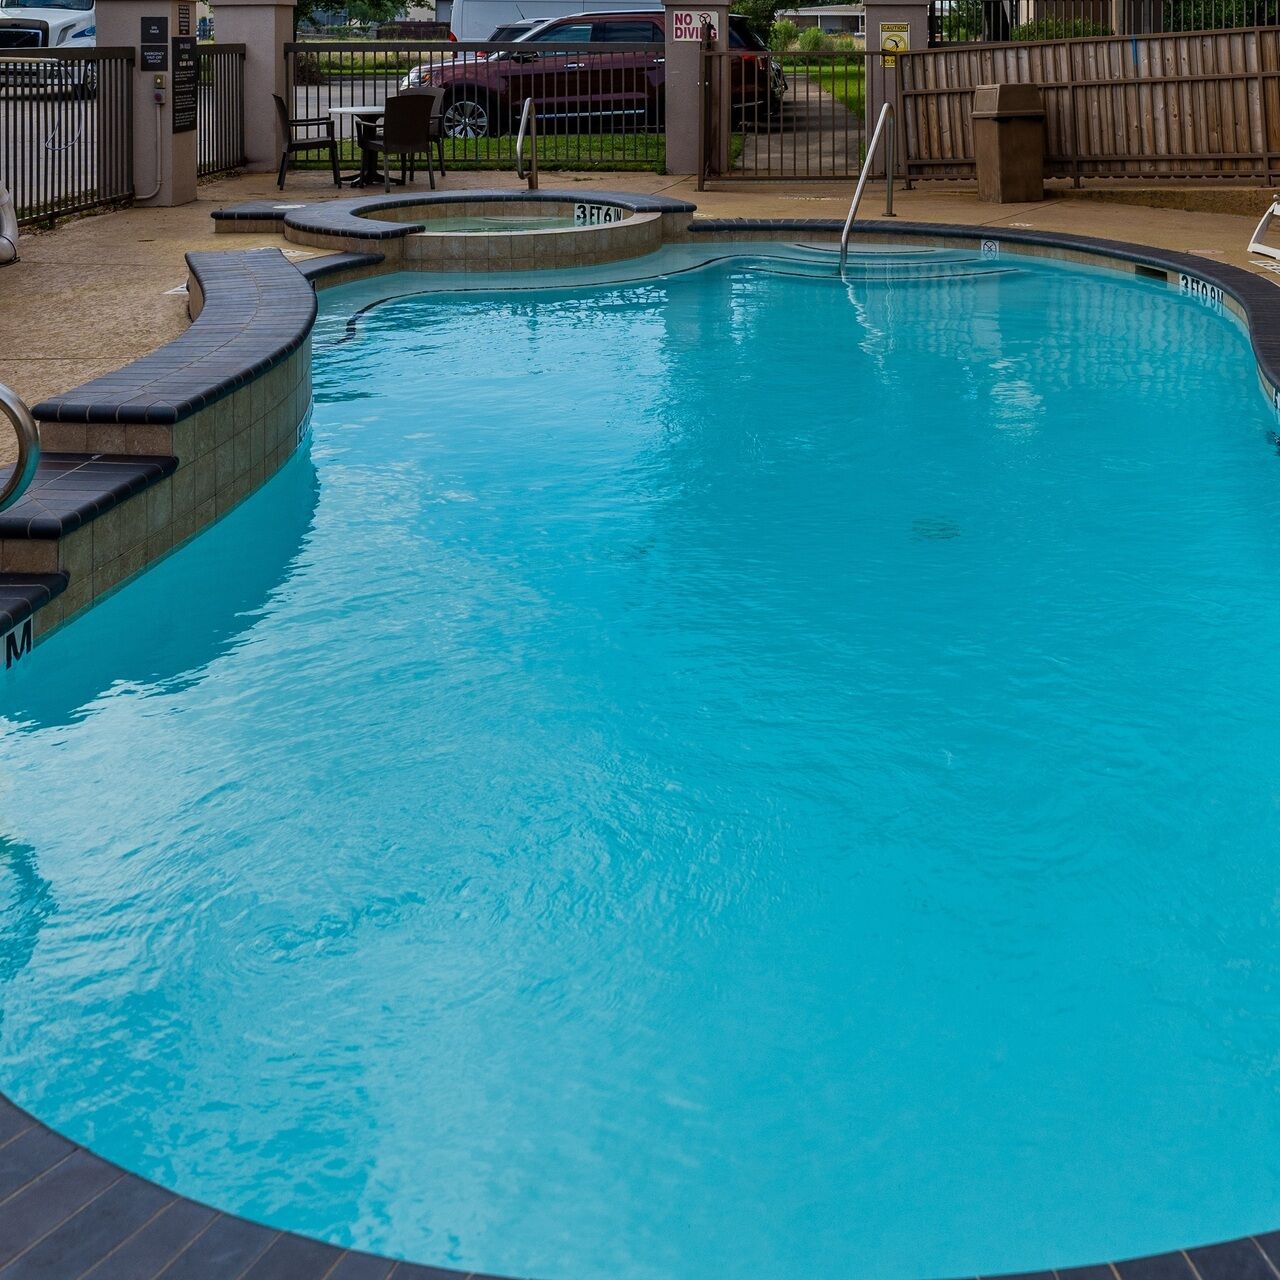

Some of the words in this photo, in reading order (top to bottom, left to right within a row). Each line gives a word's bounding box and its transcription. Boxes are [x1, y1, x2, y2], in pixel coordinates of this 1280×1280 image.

[674, 13, 692, 26] NO
[674, 26, 717, 40] DIVIG
[576, 205, 587, 221] 3
[590, 206, 602, 222] FT
[604, 208, 612, 222] 6
[614, 208, 622, 222] IN
[1181, 274, 1189, 290] 3
[6, 617, 34, 670] M
